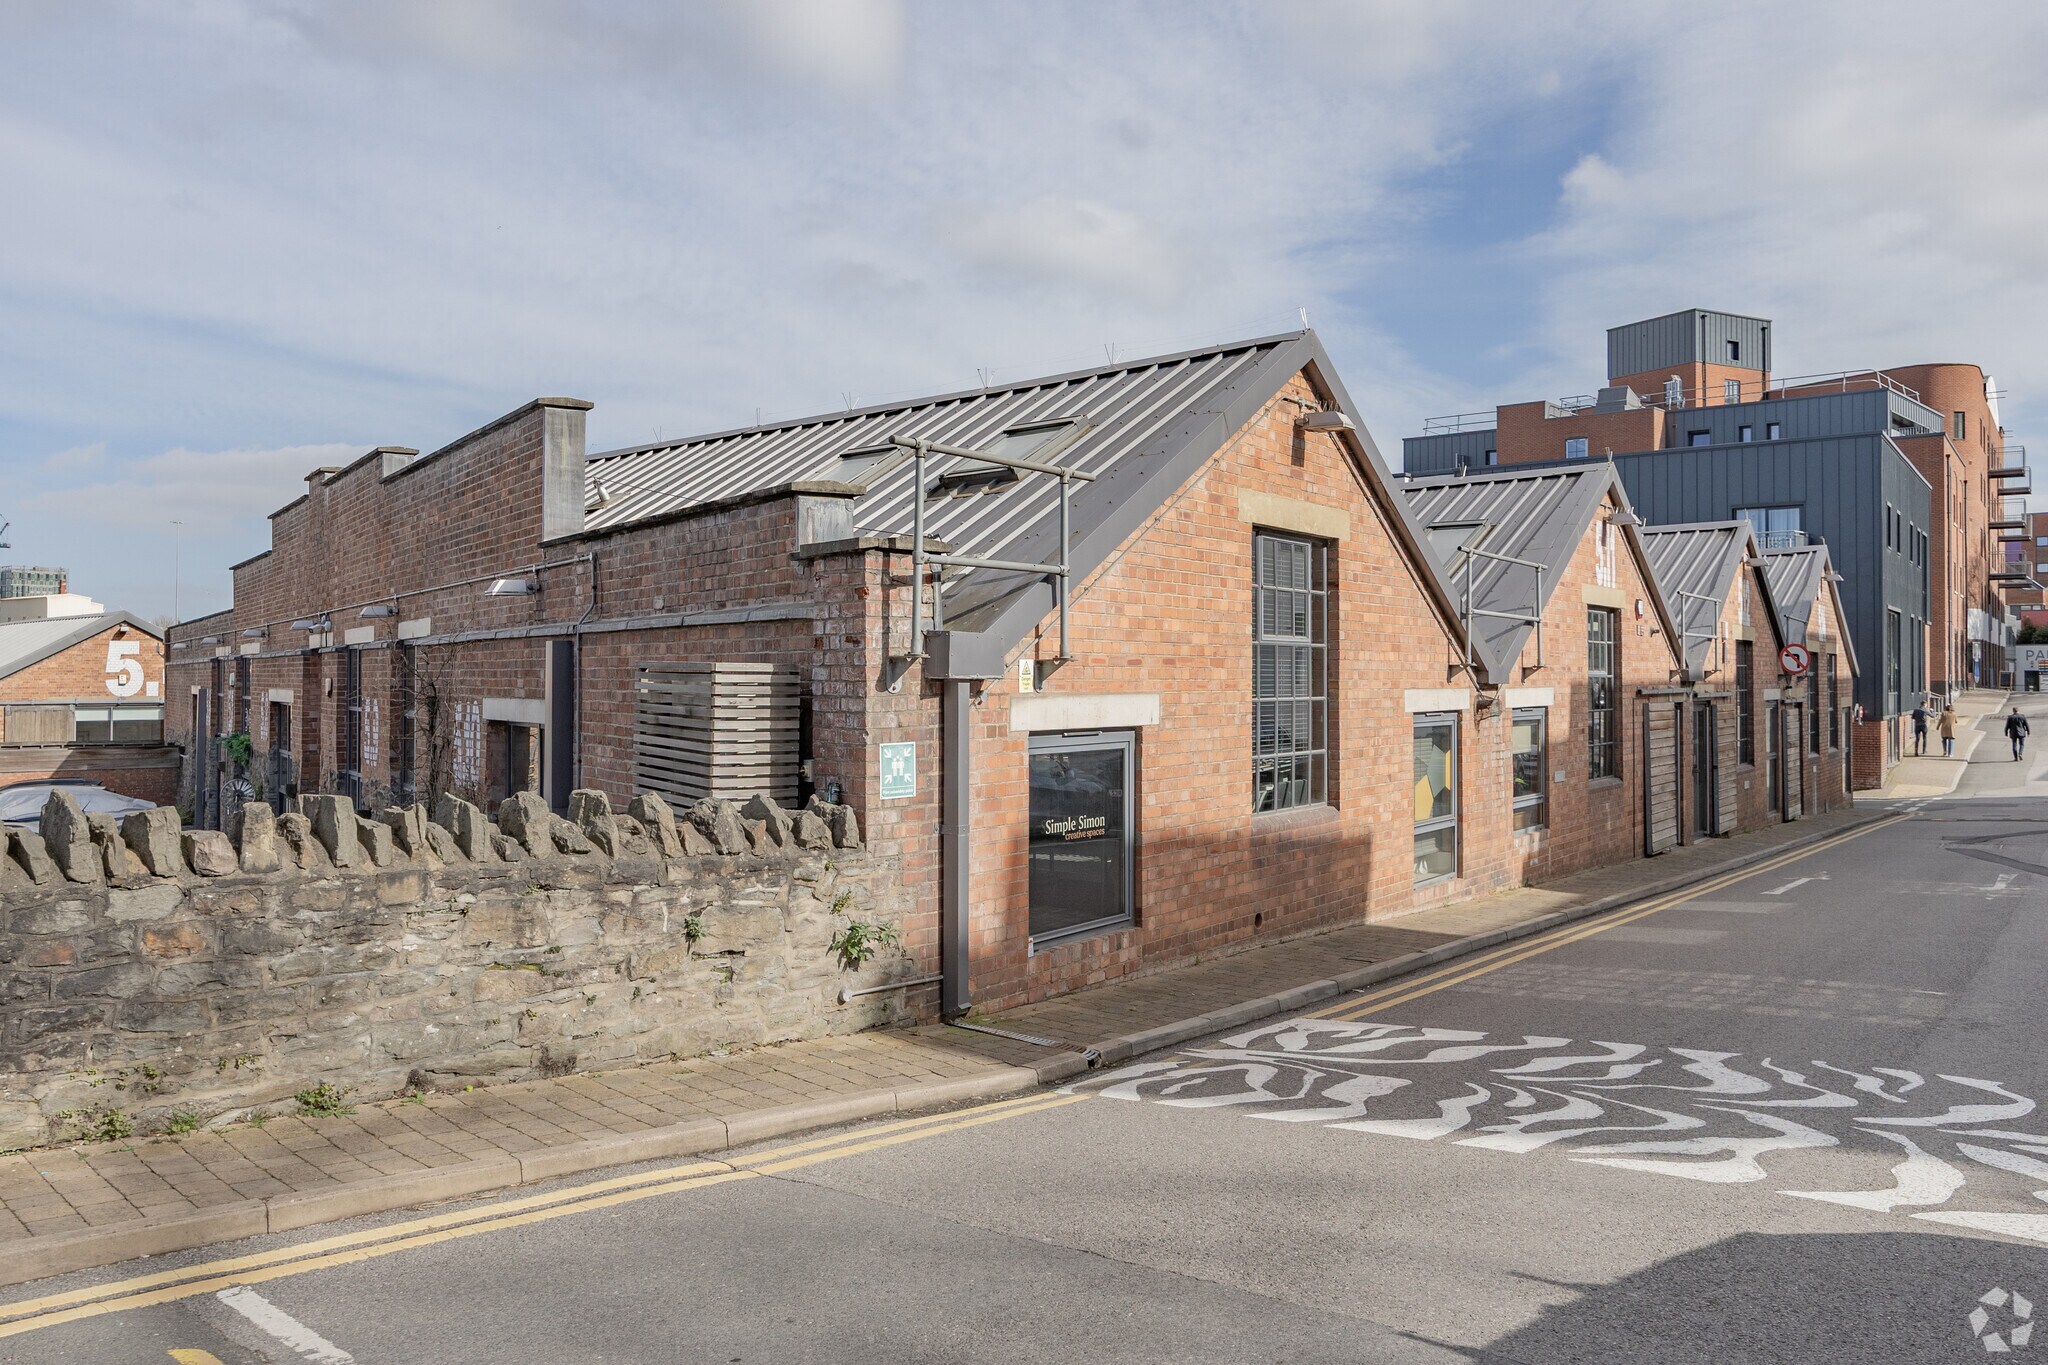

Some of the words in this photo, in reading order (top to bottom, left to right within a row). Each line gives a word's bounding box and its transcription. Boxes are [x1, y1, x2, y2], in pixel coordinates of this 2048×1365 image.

[105, 640, 159, 697] 5.
[1045, 817, 1076, 836] Simple
[1078, 814, 1106, 829] Simon
[1065, 829, 1086, 840] creative
[1086, 828, 1105, 839] spaces
